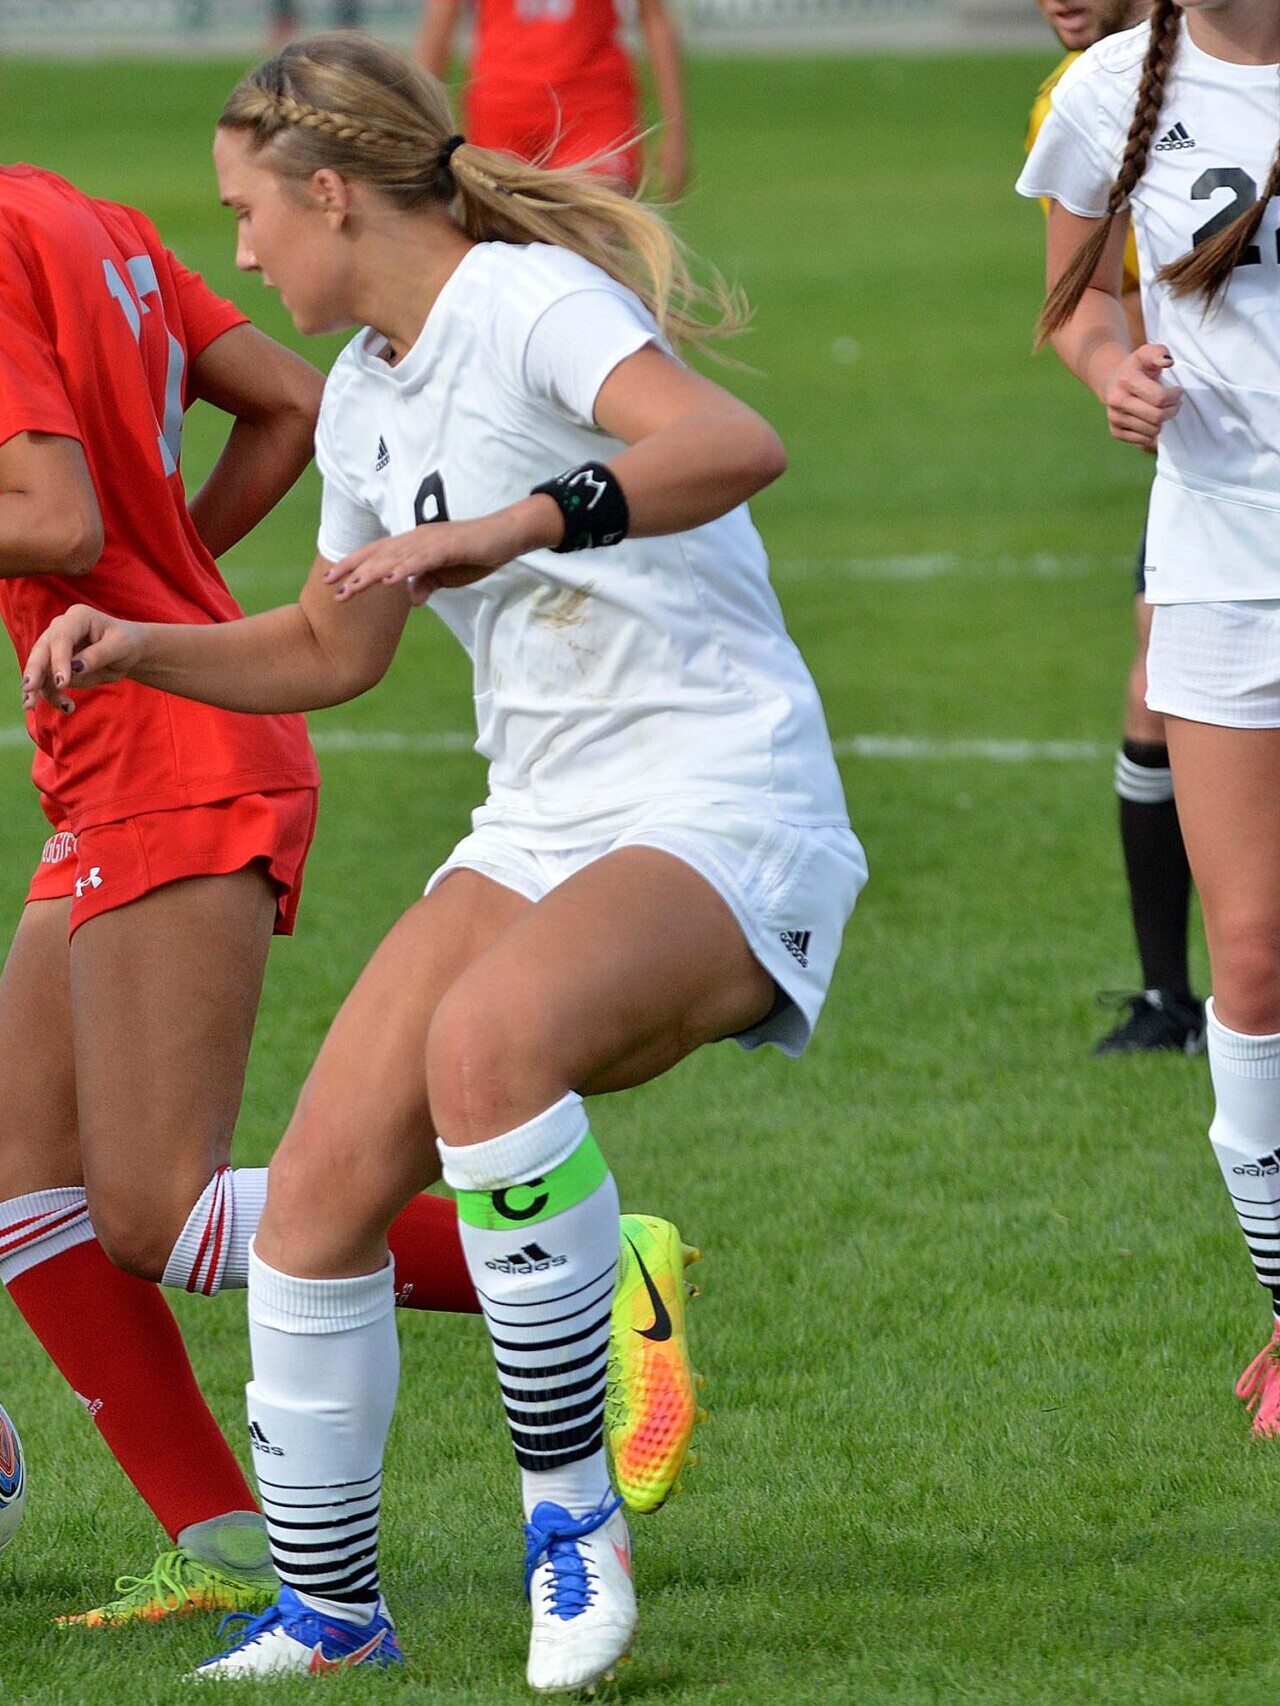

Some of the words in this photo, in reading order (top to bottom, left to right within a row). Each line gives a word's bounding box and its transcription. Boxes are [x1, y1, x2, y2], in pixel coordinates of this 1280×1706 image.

[1154, 138, 1196, 152] adidas
[1191, 168, 1280, 268] 2
[1232, 1164, 1280, 1177] adid
[492, 1177, 549, 1220] C
[484, 1255, 568, 1275] adidas
